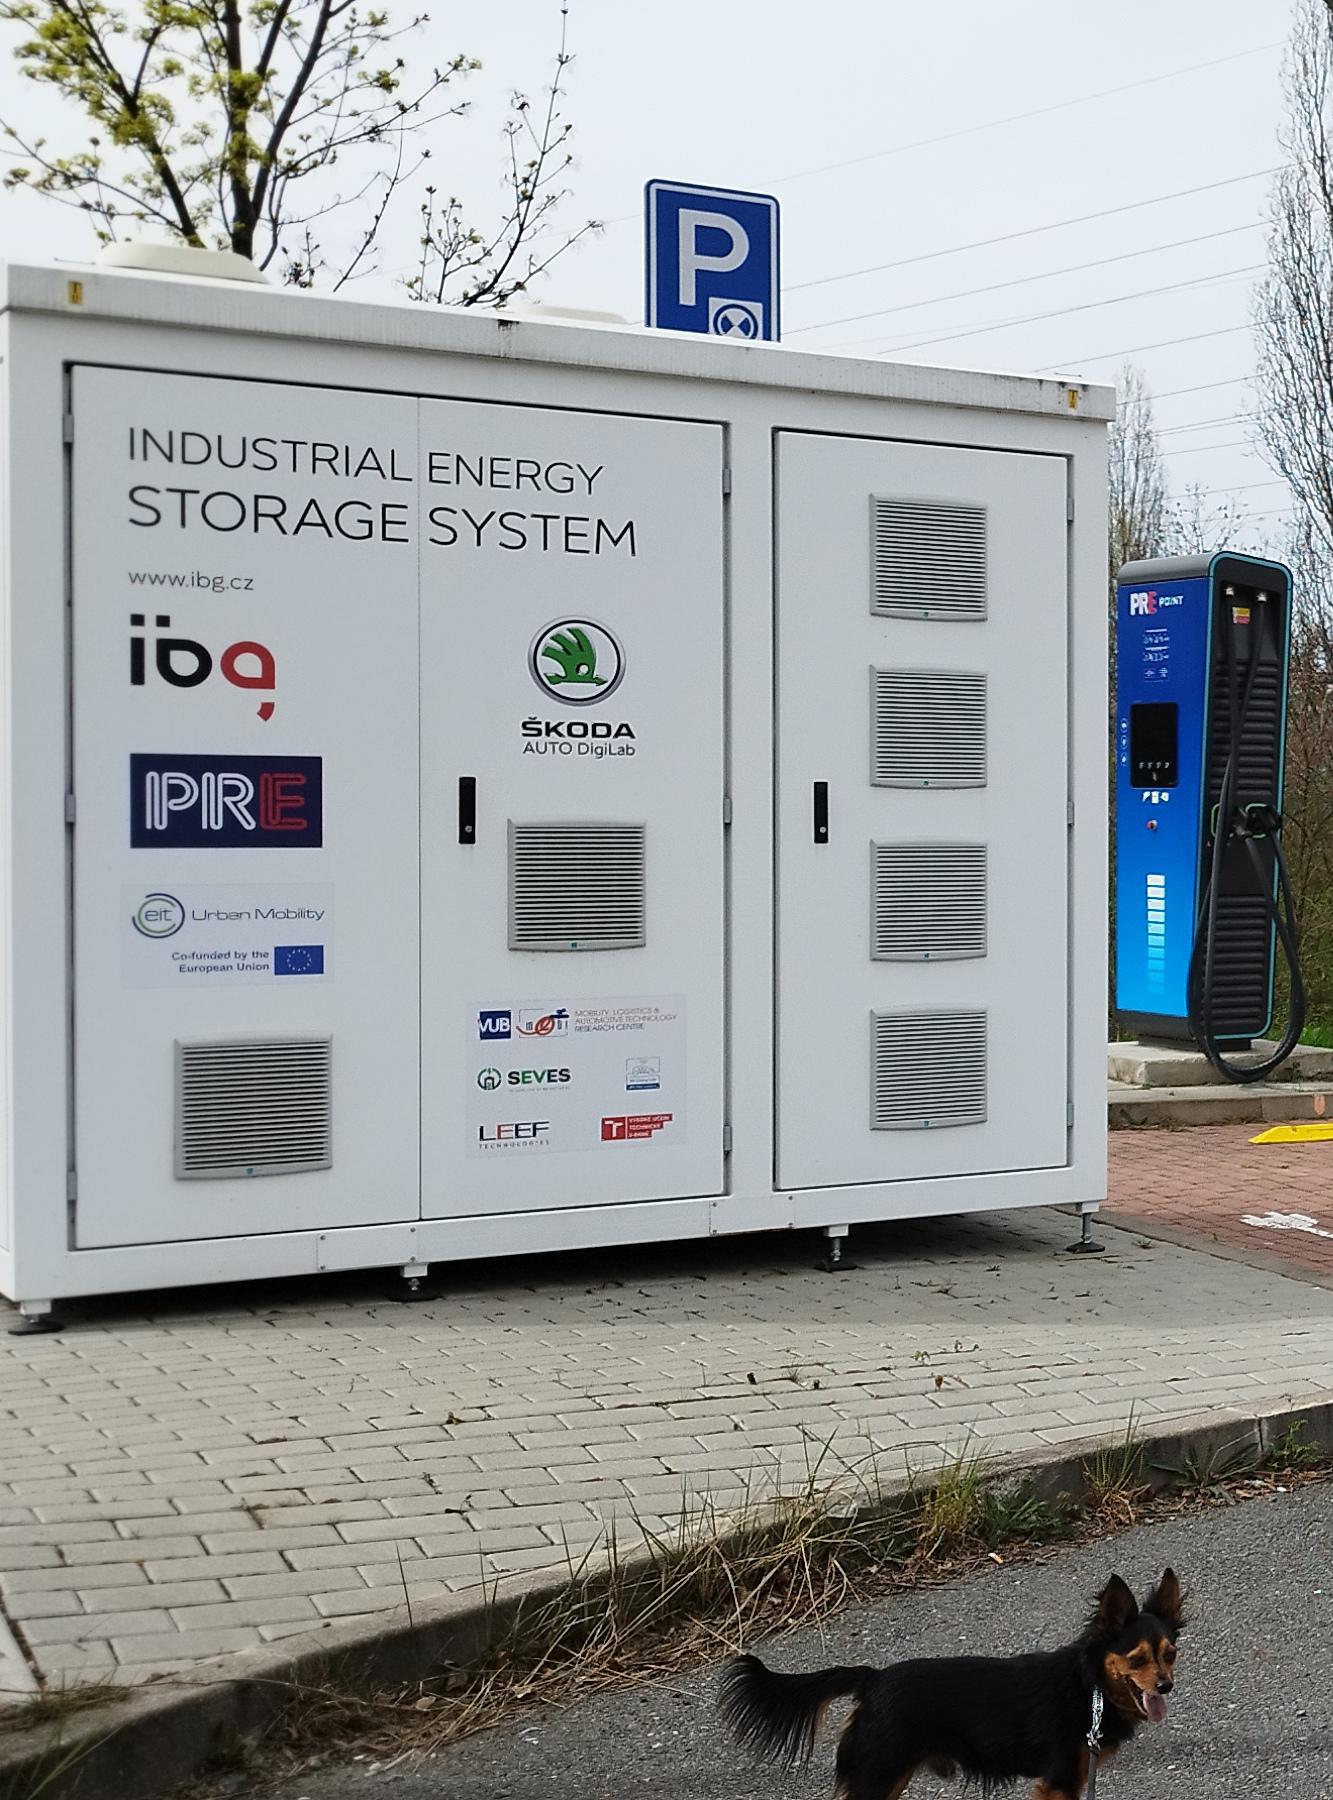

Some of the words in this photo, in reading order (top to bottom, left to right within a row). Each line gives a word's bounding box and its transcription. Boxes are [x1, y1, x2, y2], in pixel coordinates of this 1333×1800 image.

[679, 208, 750, 306] P
[129, 427, 413, 482] INDUSTRIAL
[428, 452, 605, 495] ENERGY
[128, 486, 409, 543] STORAGE
[428, 507, 637, 557] SYSTEM
[128, 570, 254, 593] www.ibg.cz
[1129, 591, 1158, 616] PRE
[1158, 595, 1184, 608] POINT
[130, 613, 276, 722] ibg
[521, 716, 636, 739] ŠKODA
[522, 741, 573, 756] AUTO
[577, 742, 636, 759] DigiLab
[145, 771, 307, 831] PRE
[144, 907, 173, 922] eit
[191, 909, 251, 921] Urban
[254, 907, 326, 921] Mobility
[171, 951, 231, 961] Co-funded
[234, 951, 248, 961] by
[251, 950, 270, 960] the
[179, 963, 233, 974] European
[236, 962, 270, 972] Union
[480, 1017, 511, 1034] VUB
[507, 1068, 571, 1085] SEVES
[479, 1121, 549, 1141] LEEF
